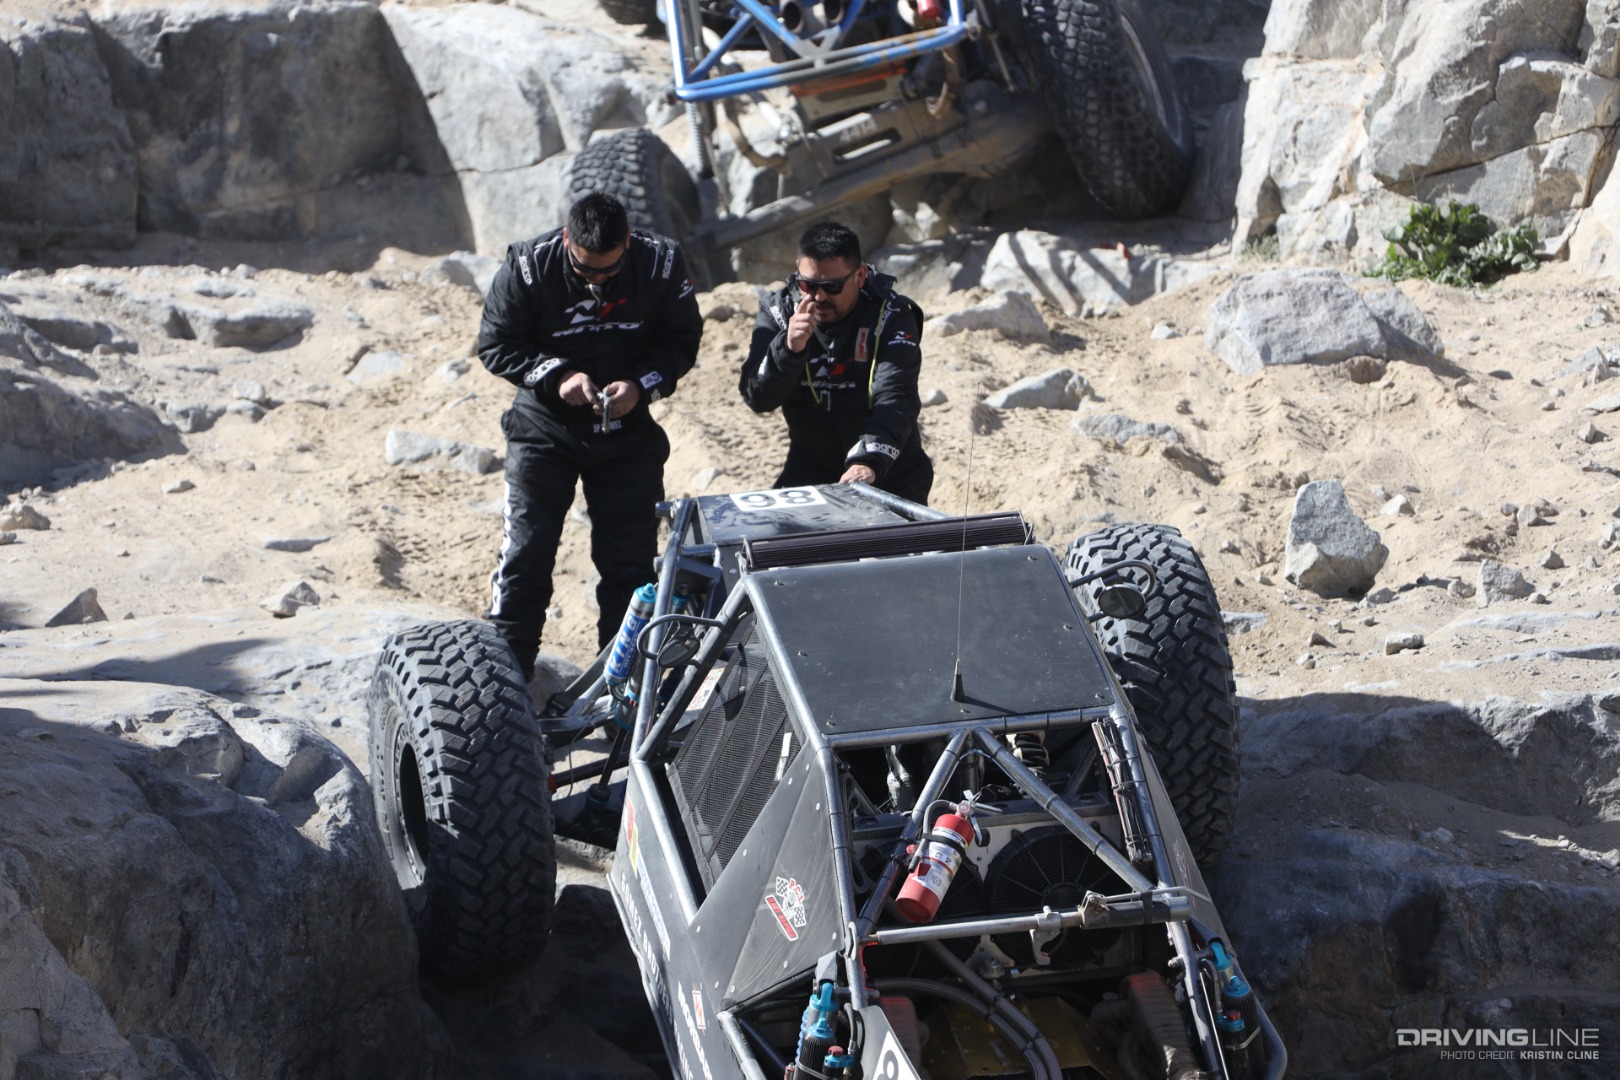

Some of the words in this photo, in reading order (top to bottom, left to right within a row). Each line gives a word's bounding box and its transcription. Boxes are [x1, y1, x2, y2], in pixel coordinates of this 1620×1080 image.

[740, 490, 816, 508] 98
[609, 614, 638, 674] KING
[621, 872, 643, 938] GOMEZ
